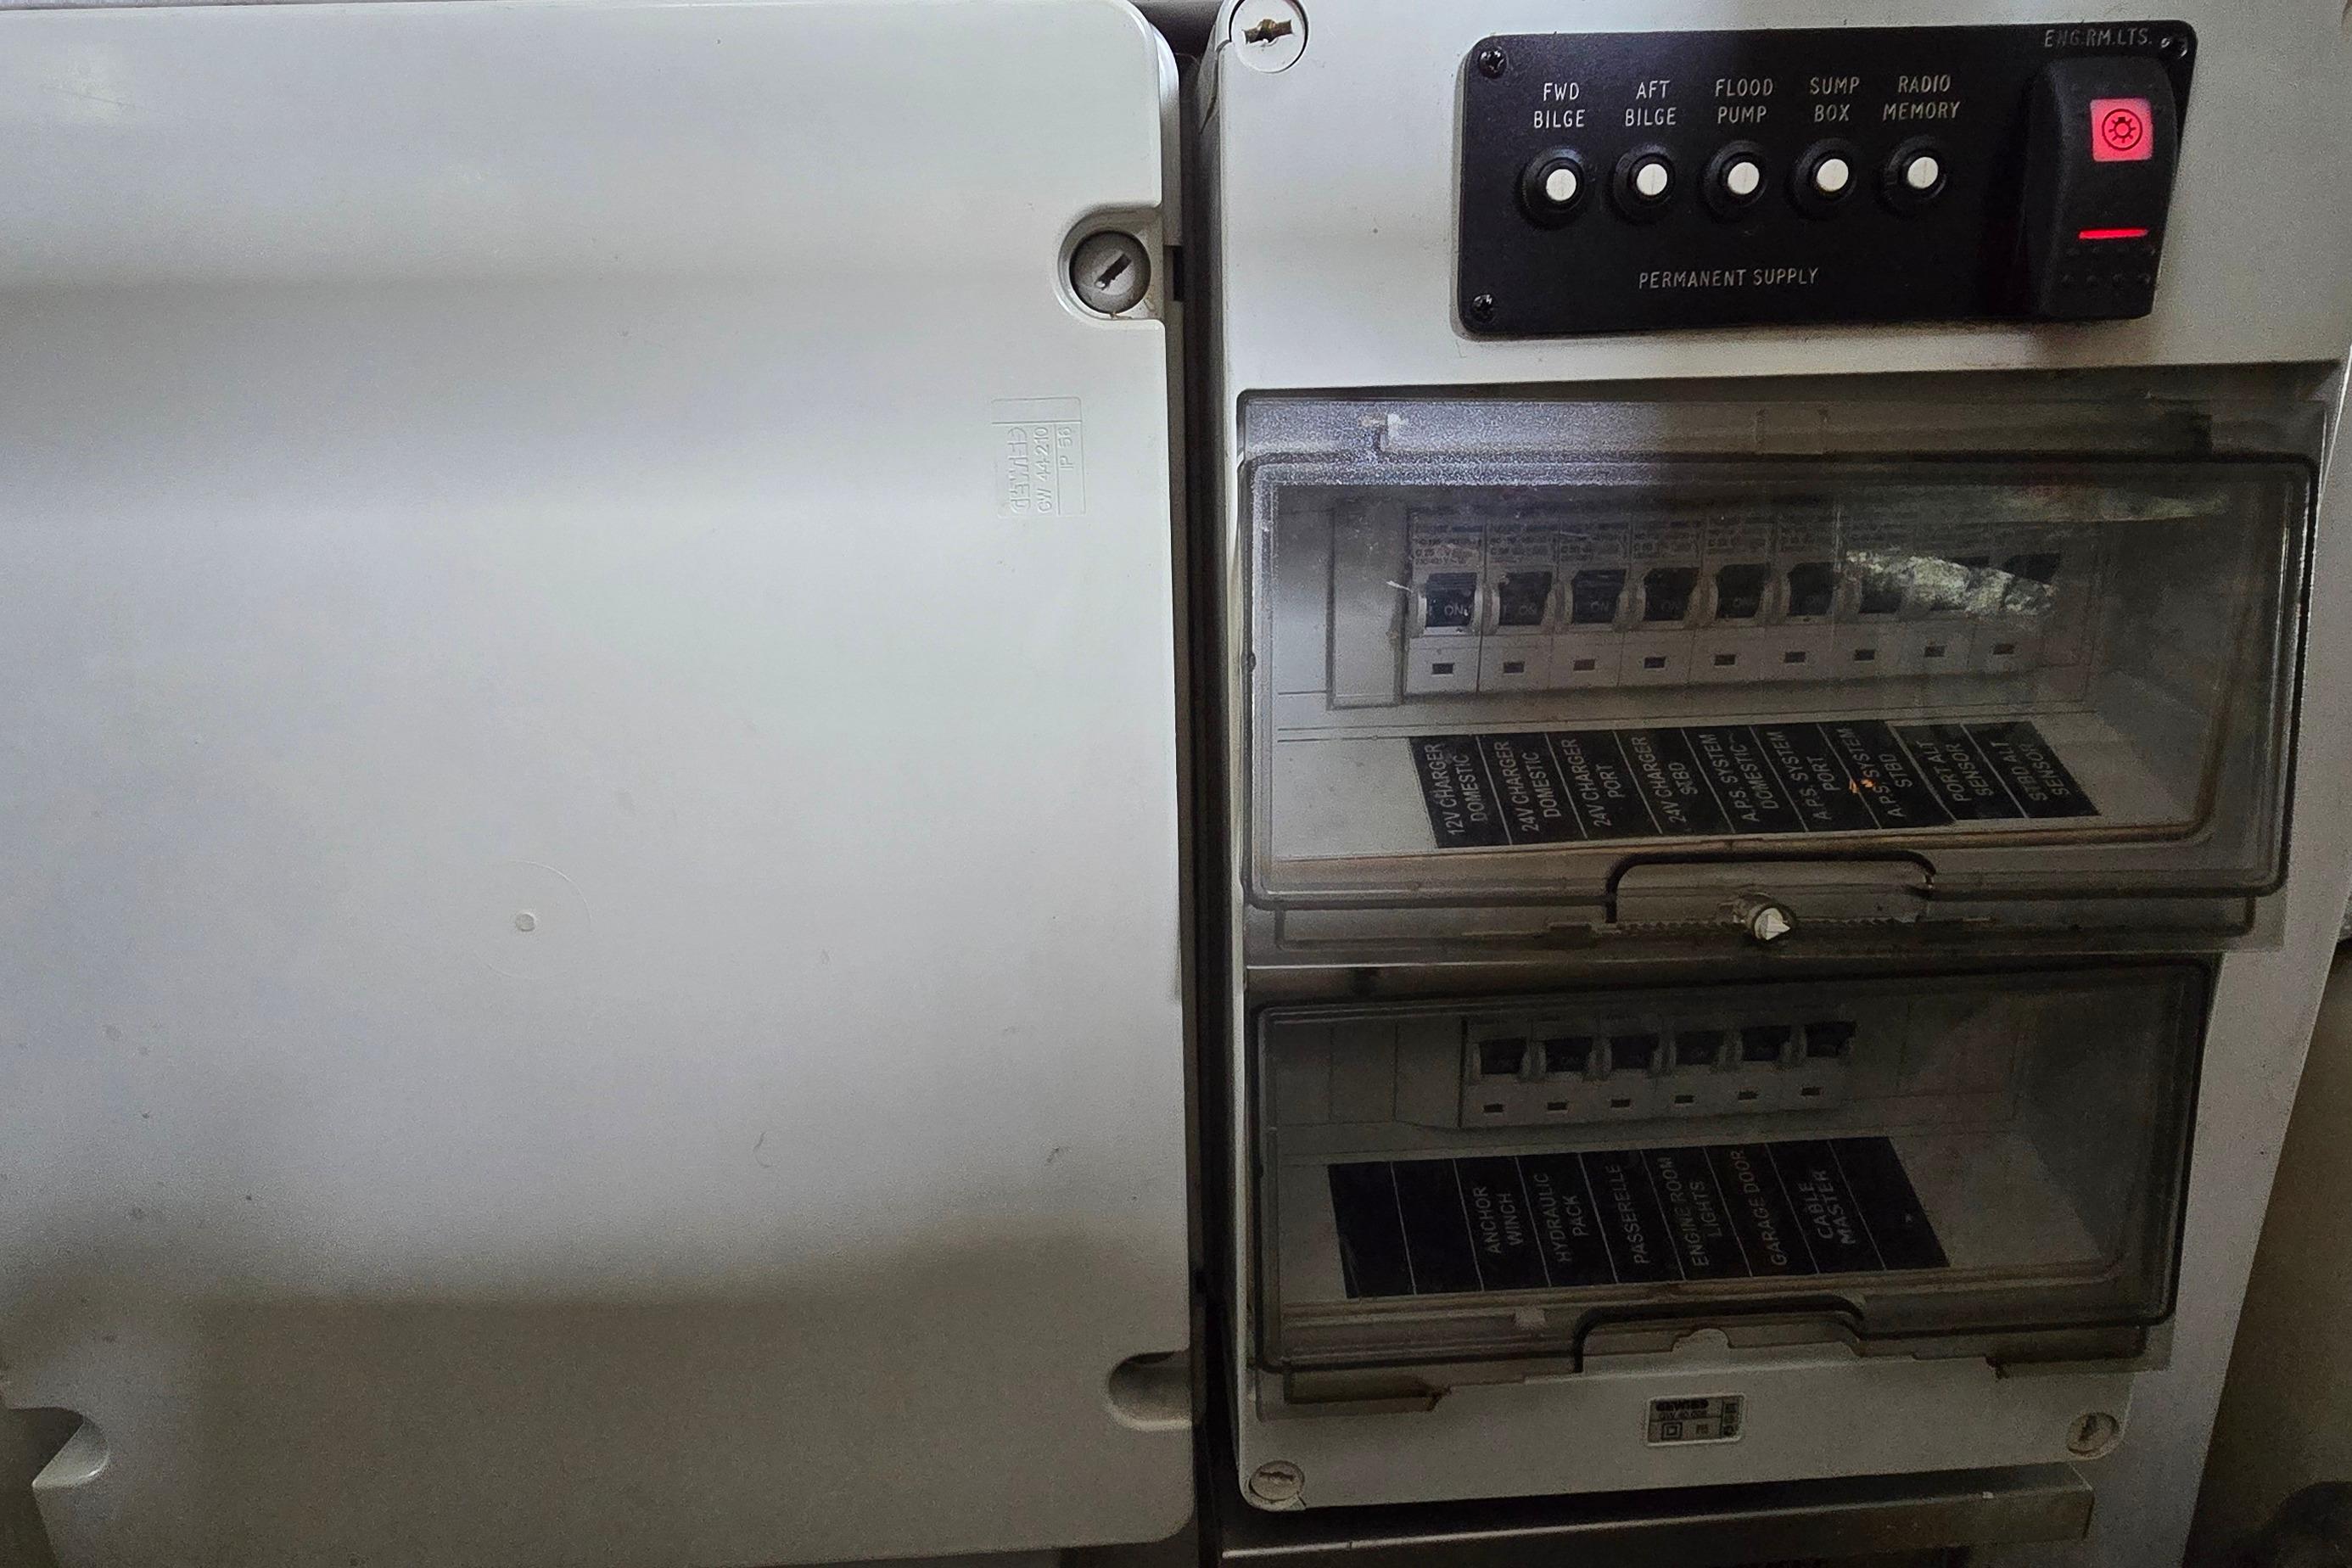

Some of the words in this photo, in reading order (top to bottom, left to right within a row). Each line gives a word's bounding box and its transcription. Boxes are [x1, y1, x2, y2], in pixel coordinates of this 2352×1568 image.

[1543, 82, 1580, 102] FWD
[1636, 80, 1671, 99] AFT
[1715, 77, 1773, 97] FLOOD
[1809, 76, 1860, 96] SUMP
[1898, 74, 1951, 93] RADIO
[1533, 108, 1586, 128] BILGE
[1625, 105, 1677, 126] BILGE
[1716, 104, 1767, 124] PUMP
[1814, 103, 1850, 123] BOX
[1882, 99, 1960, 121] MEMORY
[1638, 268, 1746, 289] PERMANENT
[1753, 266, 1819, 287] SUPPLY
[1060, 456, 1074, 470] IP
[1444, 603, 1463, 617] ON
[1590, 599, 1610, 612] ON
[1632, 736, 1672, 798] CHARGER
[1699, 734, 1738, 783] SYSTEM
[1767, 731, 1809, 781] SYSTEM
[1836, 728, 1879, 778] SYSTEM
[1916, 740, 1946, 764] ALT
[1946, 743, 1995, 797] SENSOR
[2018, 742, 2071, 797] SENSOR
[1425, 743, 1458, 808] CHARGER
[1453, 753, 1487, 822] DOMESTIC
[1494, 741, 1529, 807] CHARGER
[1522, 752, 1561, 818] DOMESTIC
[1561, 739, 1599, 803] CHARGER
[1597, 764, 1624, 798] PORT
[1668, 761, 1698, 795] STBD
[1730, 744, 1779, 809] DOMESTIC
[1807, 756, 1840, 792] PORT
[1879, 753, 1912, 788] STBD
[1934, 767, 1972, 802] PORT
[2011, 766, 2047, 801] STBD
[1444, 812, 1465, 835] 12V
[1517, 809, 1539, 832] 24V
[1585, 804, 1612, 827] 24V
[1660, 799, 1686, 823] 24V
[1657, 1156, 1687, 1204] ROOM
[1730, 1150, 1761, 1194] DOOR
[1473, 1186, 1501, 1254] ANCHOR
[1498, 1193, 1524, 1246] WINCH
[1533, 1173, 1571, 1263] HYDRAULIC
[1562, 1195, 1588, 1237] PACK
[1604, 1164, 1650, 1264] PASSERELLE
[1689, 1180, 1722, 1237] LIGHTS
[1798, 1183, 1833, 1239] CABLE
[1812, 1169, 1856, 1245] MASTER
[1673, 1206, 1709, 1267] ENGINE
[1749, 1196, 1788, 1266] GARAGE
